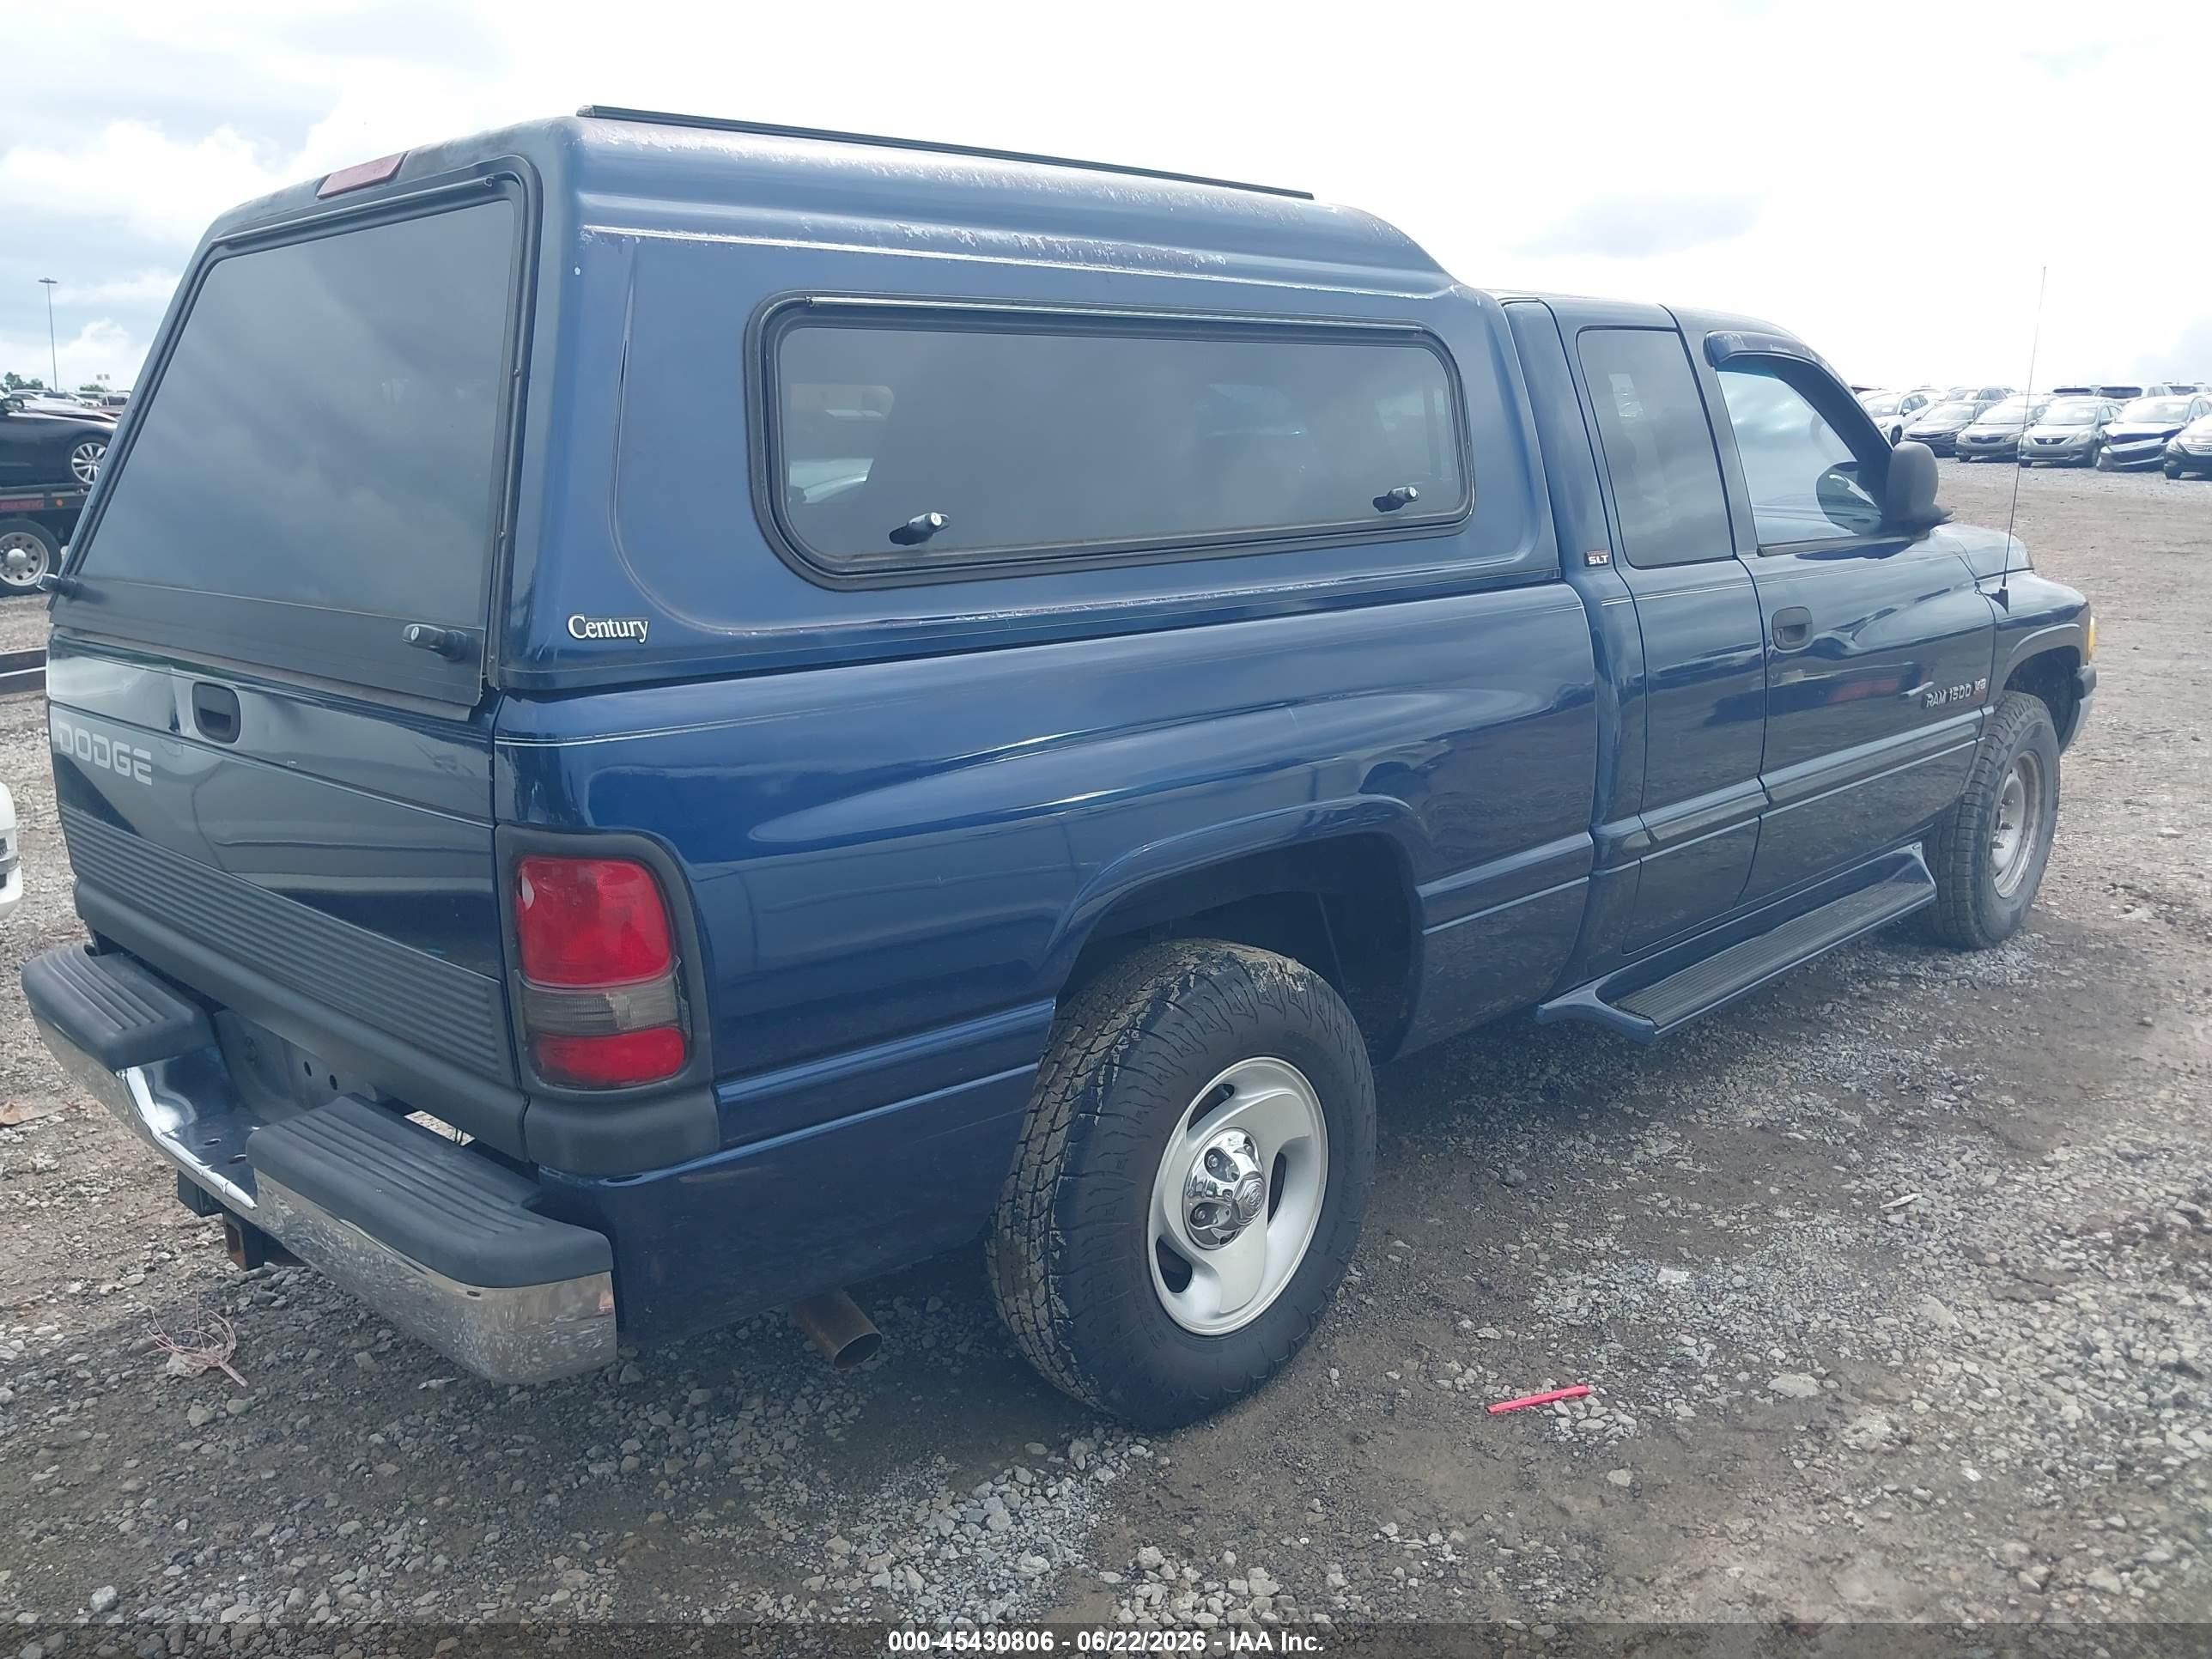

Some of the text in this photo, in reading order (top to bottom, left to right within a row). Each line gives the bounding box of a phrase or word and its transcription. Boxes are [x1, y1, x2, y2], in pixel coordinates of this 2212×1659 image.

[1589, 555, 1608, 564] SLT
[568, 615, 648, 643] Century
[1926, 690, 1947, 708] RAM
[1949, 684, 1972, 702] 1500
[57, 720, 151, 785] DODGE
